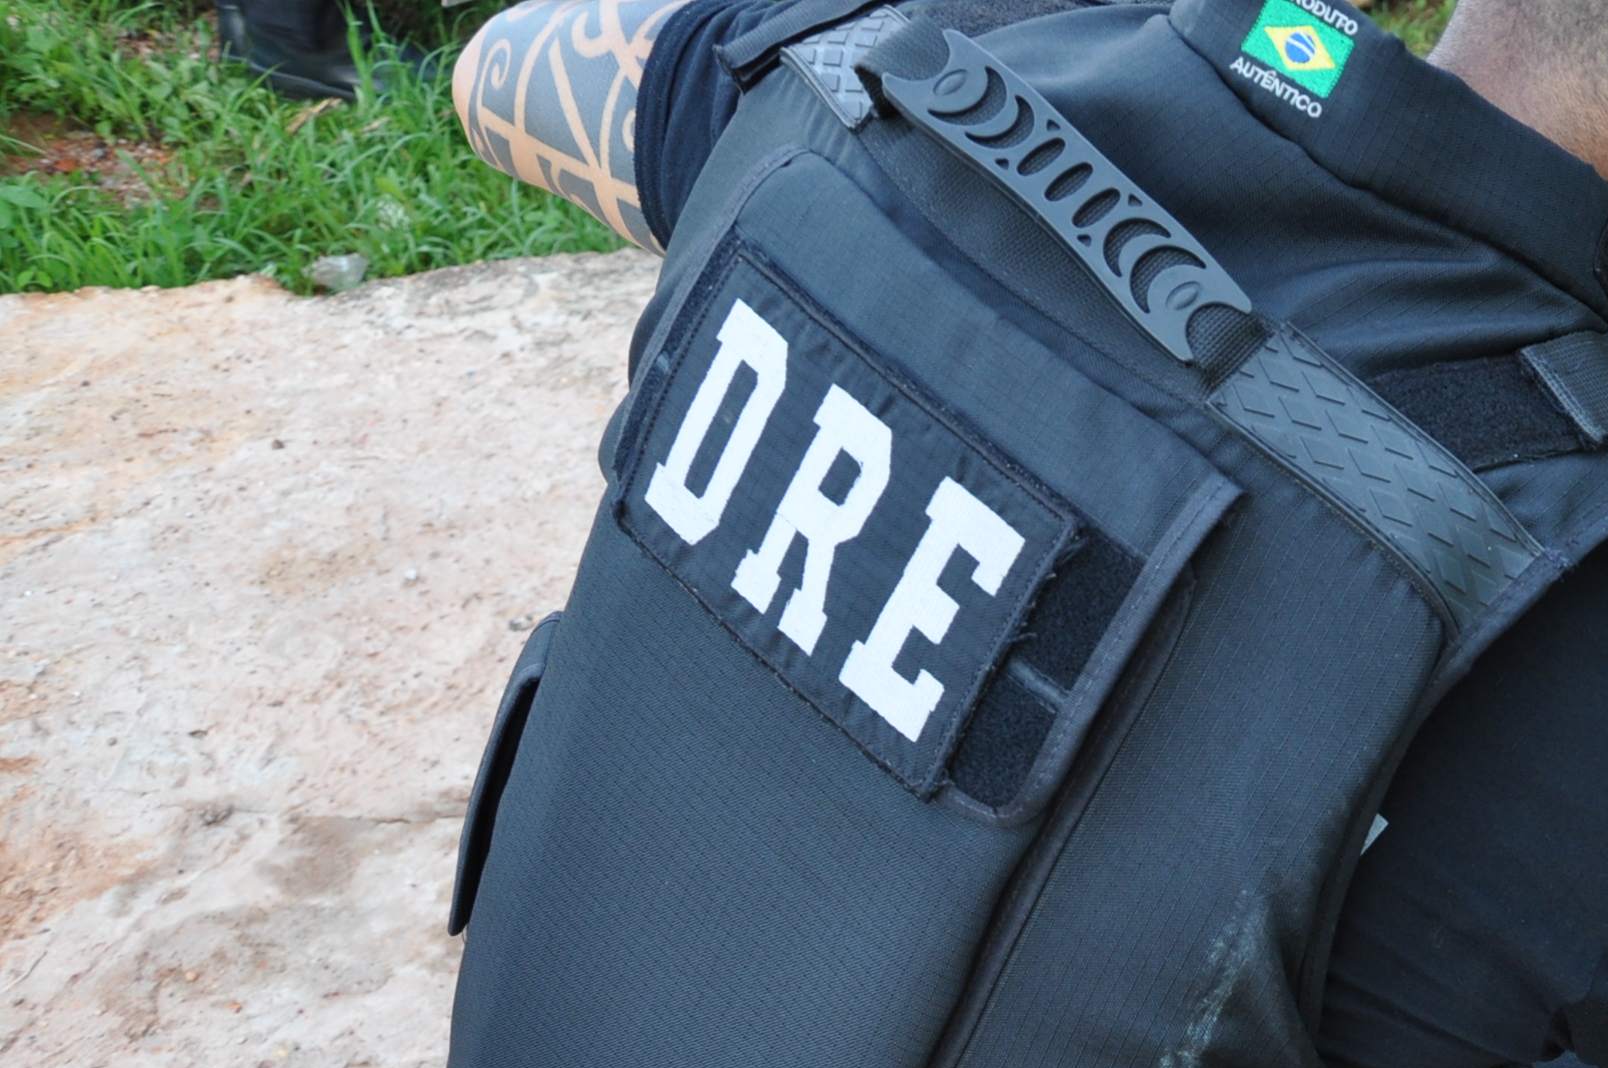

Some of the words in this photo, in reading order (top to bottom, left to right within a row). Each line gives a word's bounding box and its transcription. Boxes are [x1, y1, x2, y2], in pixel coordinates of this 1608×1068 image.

[1296, 0, 1358, 35] ODUTO
[1229, 57, 1322, 118] AUTÊNTICO
[645, 298, 1026, 742] DRE
